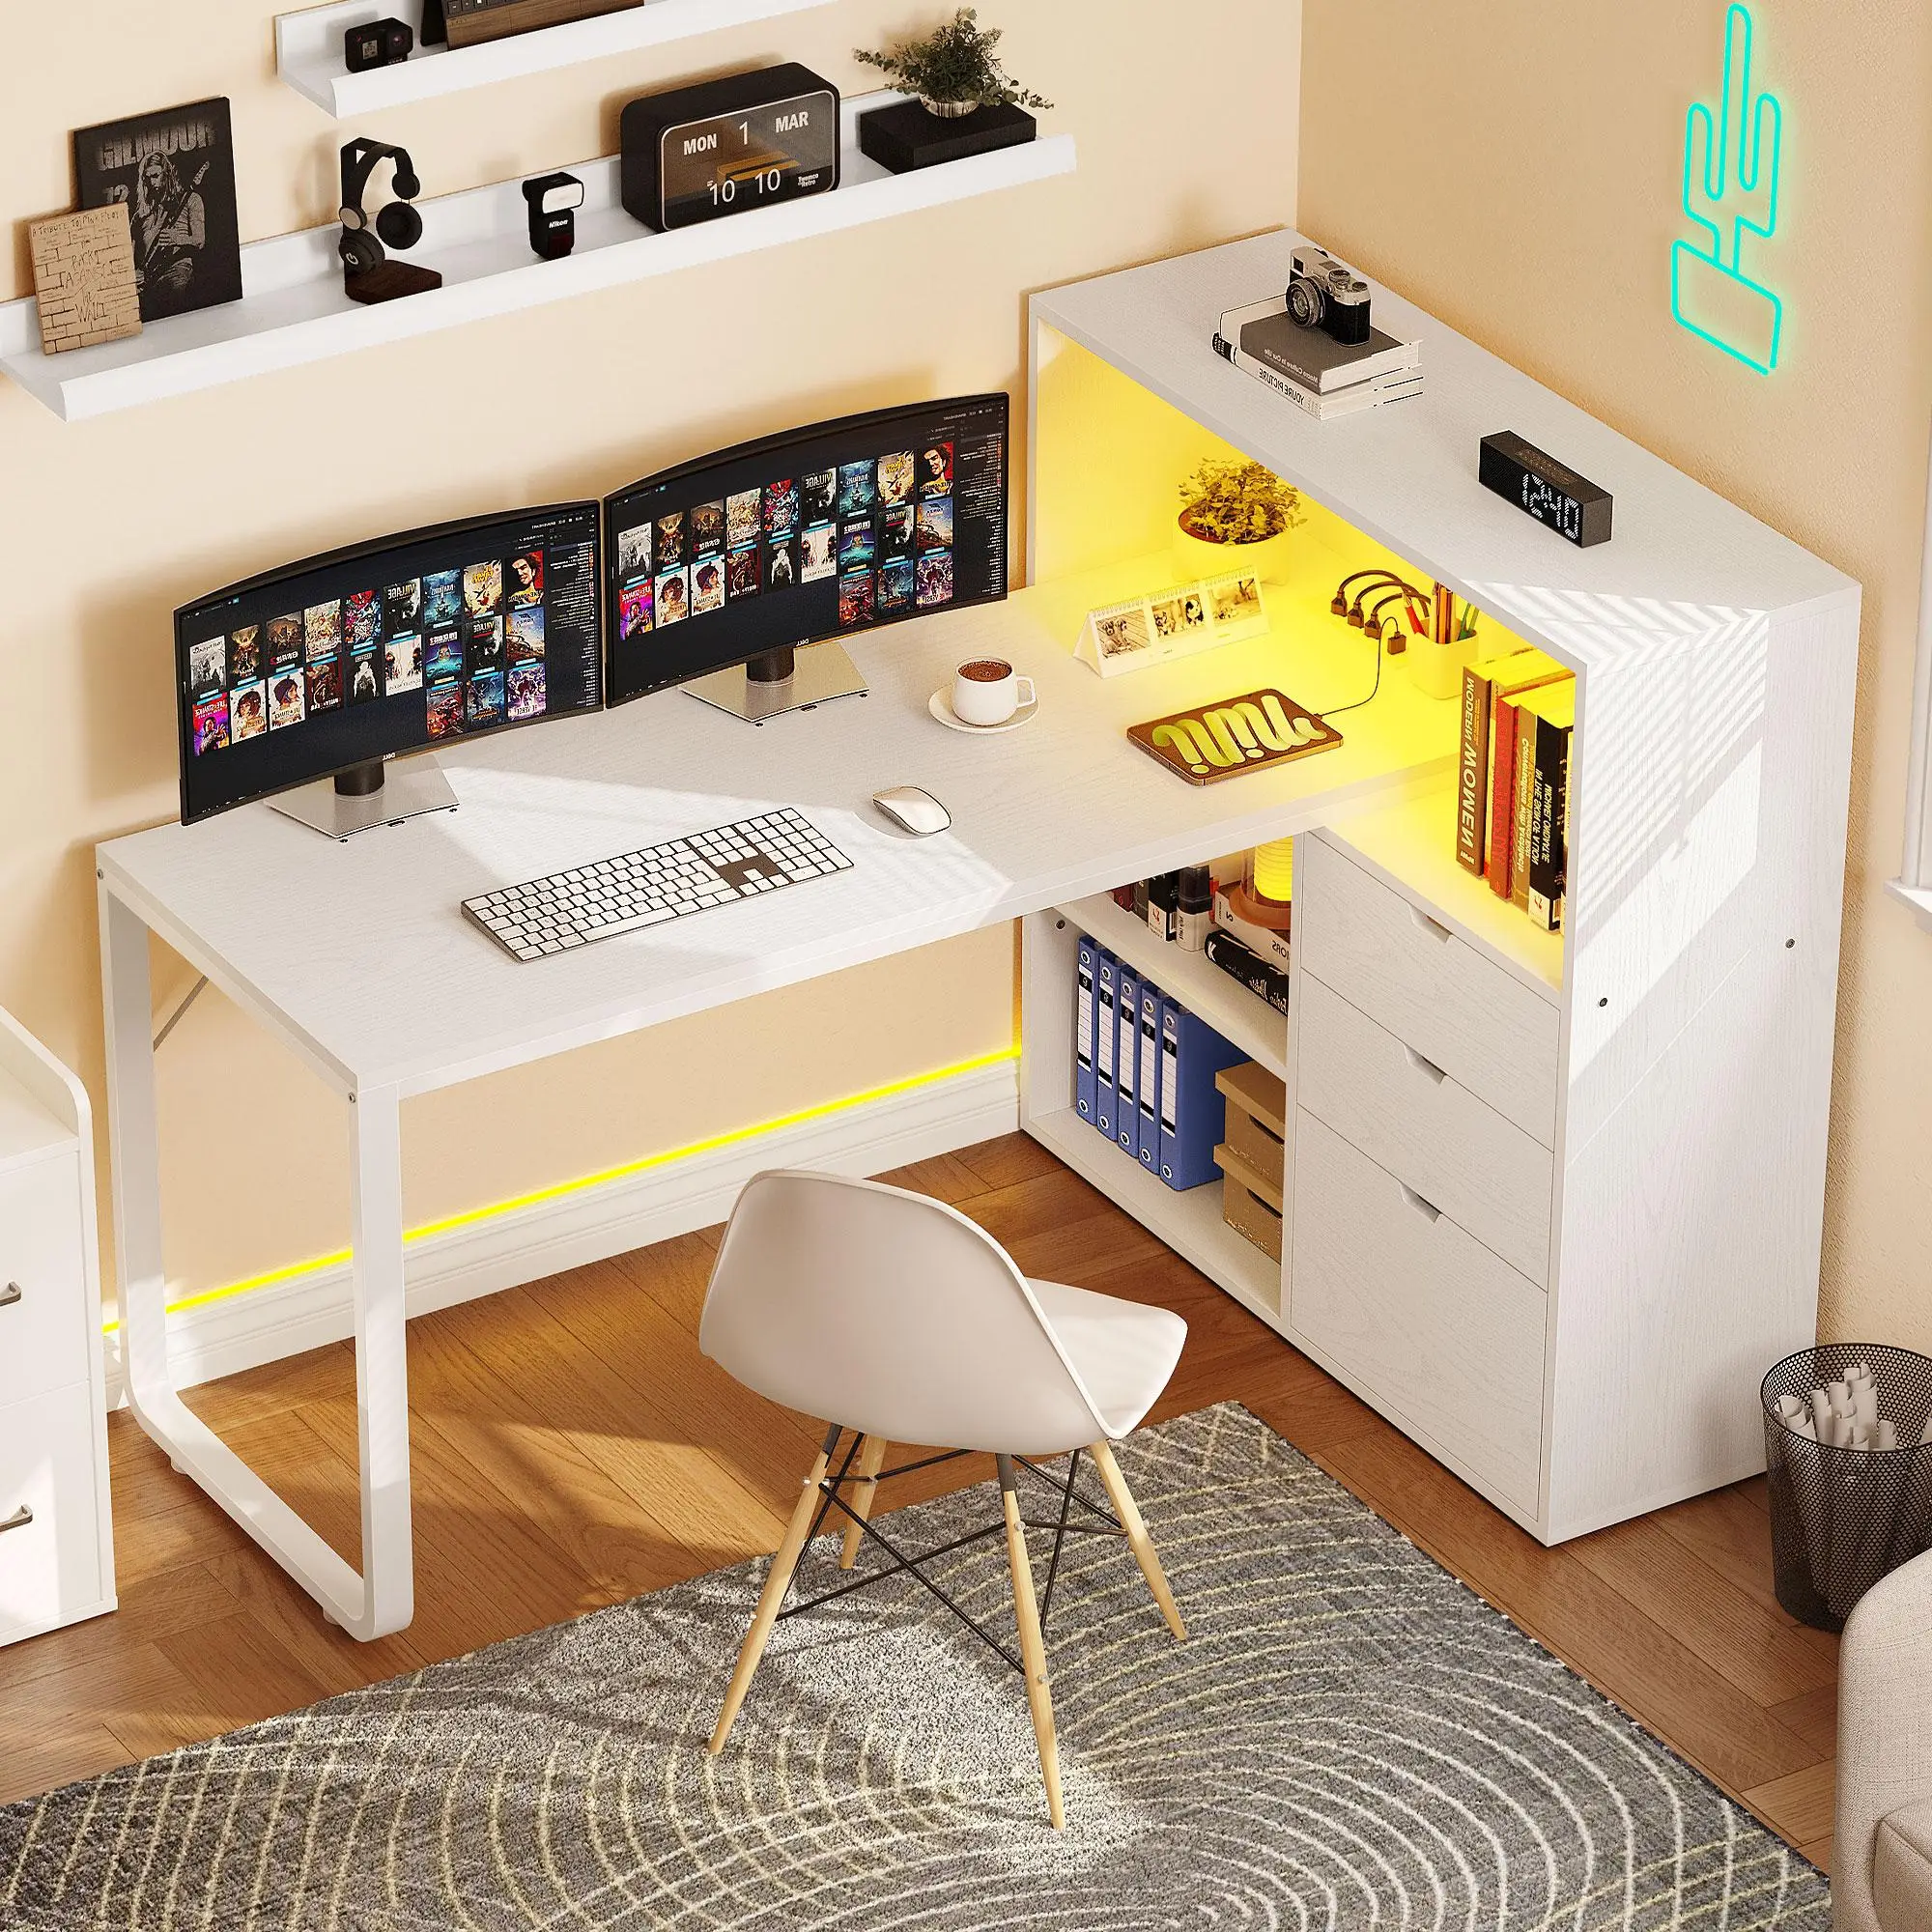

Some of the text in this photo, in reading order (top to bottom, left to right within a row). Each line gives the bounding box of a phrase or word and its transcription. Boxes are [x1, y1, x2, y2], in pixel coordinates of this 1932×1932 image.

[683, 111, 810, 156] MON 1 MAR
[709, 168, 781, 206] 10 10
[549, 219, 568, 229] Nikon
